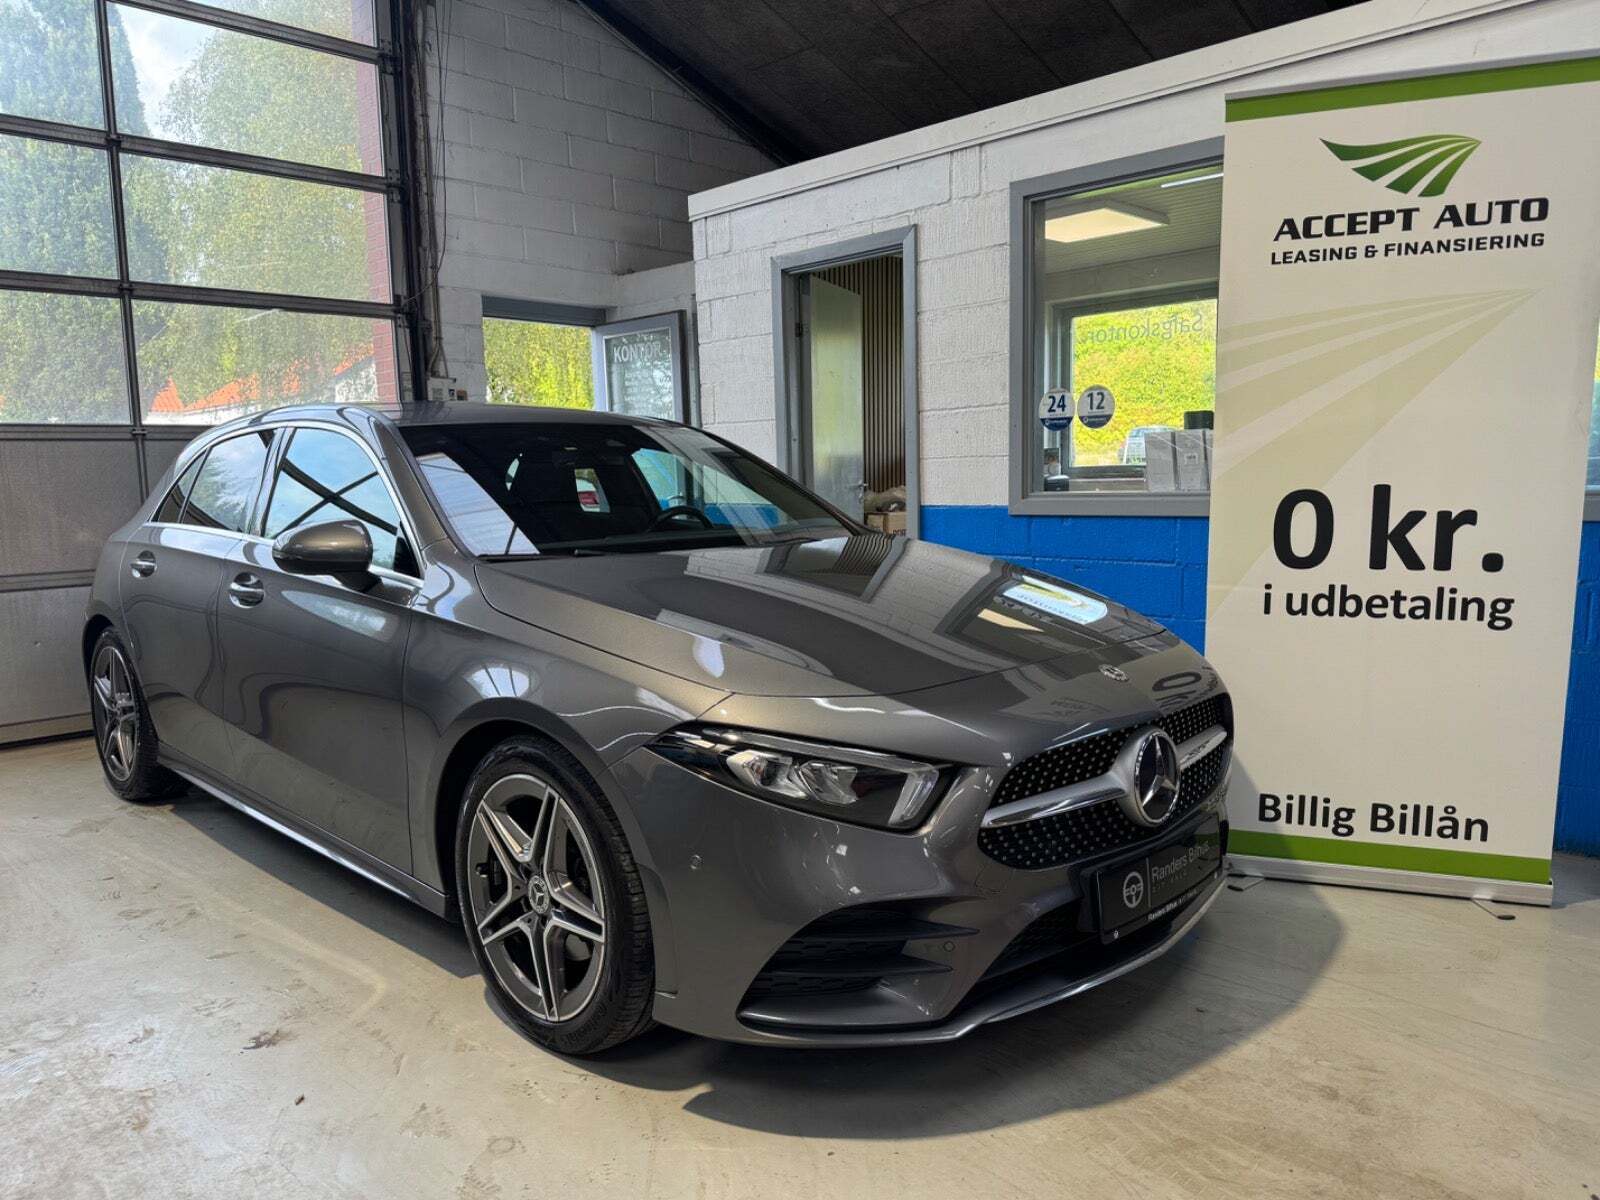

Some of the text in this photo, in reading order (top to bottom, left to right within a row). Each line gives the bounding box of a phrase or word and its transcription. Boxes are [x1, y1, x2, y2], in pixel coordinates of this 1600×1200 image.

[1273, 197, 1549, 242] ACCEPT AUTO
[1271, 232, 1545, 265] LEASING & FINANSIERING
[613, 341, 662, 363] KONTOR
[1047, 394, 1066, 413] 24
[1087, 391, 1105, 410] 12
[1272, 483, 1504, 573] 0 kr.
[1263, 583, 1515, 631] i udbetaling
[1257, 793, 1490, 842] Billig Billån
